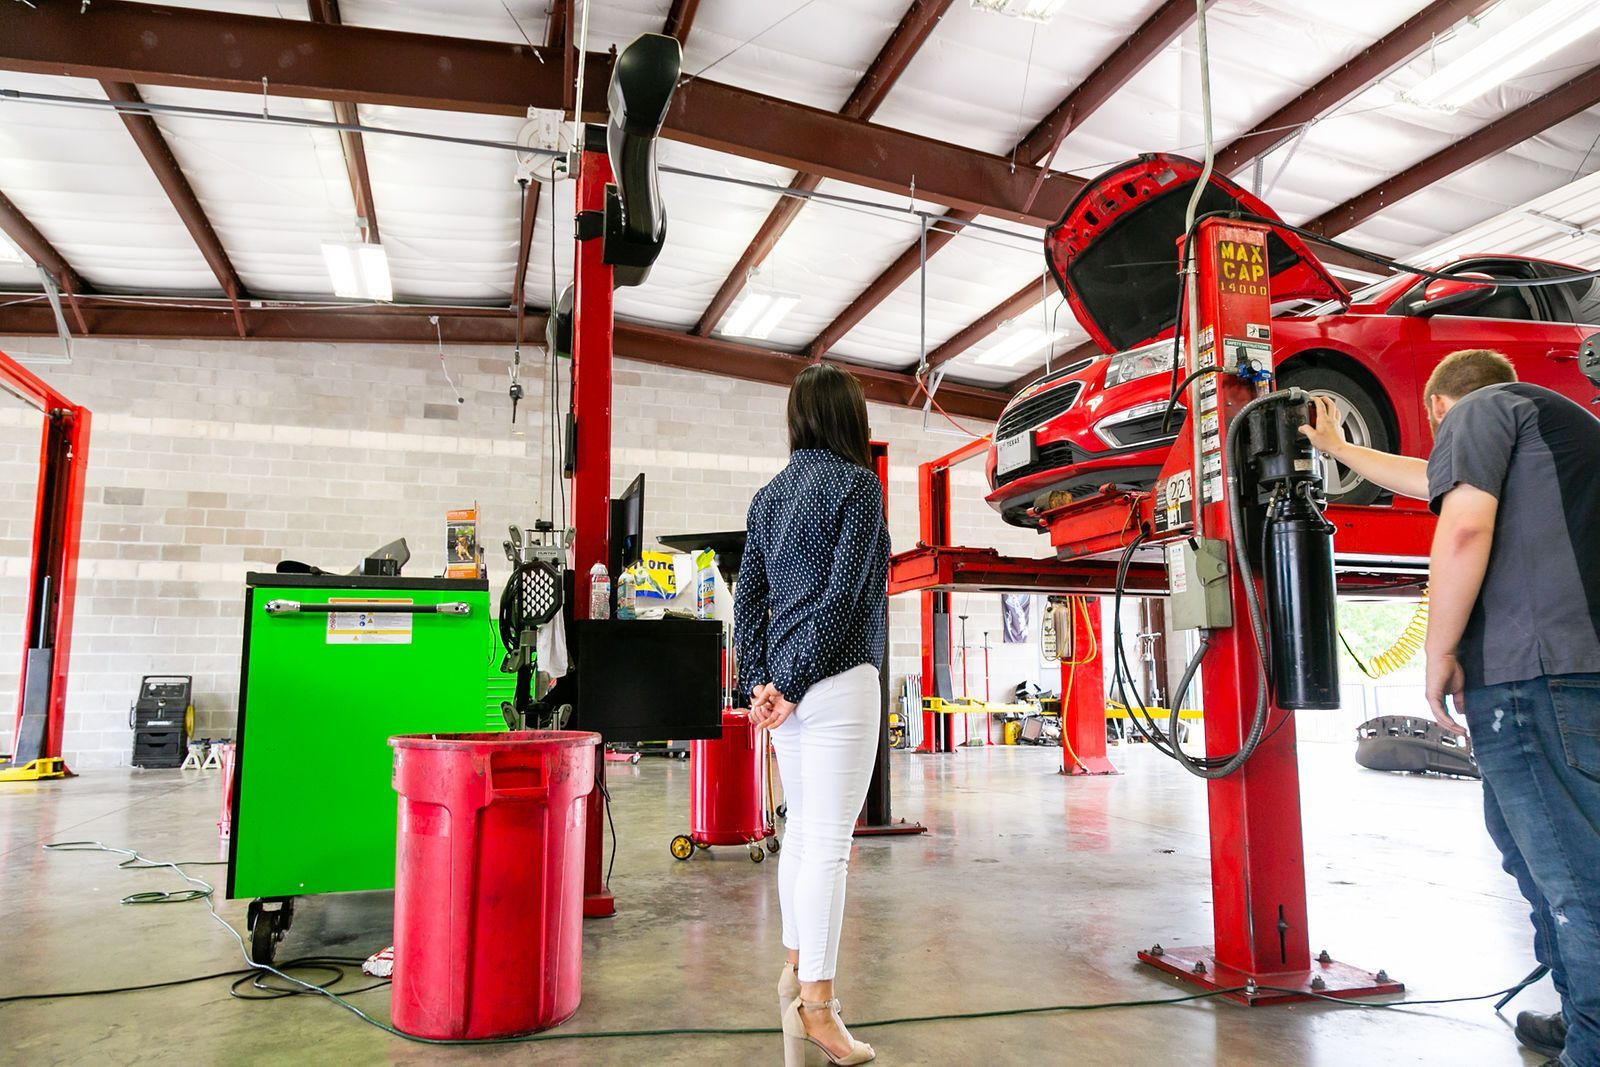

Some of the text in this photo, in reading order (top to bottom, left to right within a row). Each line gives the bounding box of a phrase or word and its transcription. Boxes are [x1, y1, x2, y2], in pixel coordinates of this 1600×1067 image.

[1221, 242, 1263, 263] MAX
[1223, 262, 1264, 282] CAP
[1220, 282, 1267, 296] 14000
[1007, 437, 1020, 447] TEXAS
